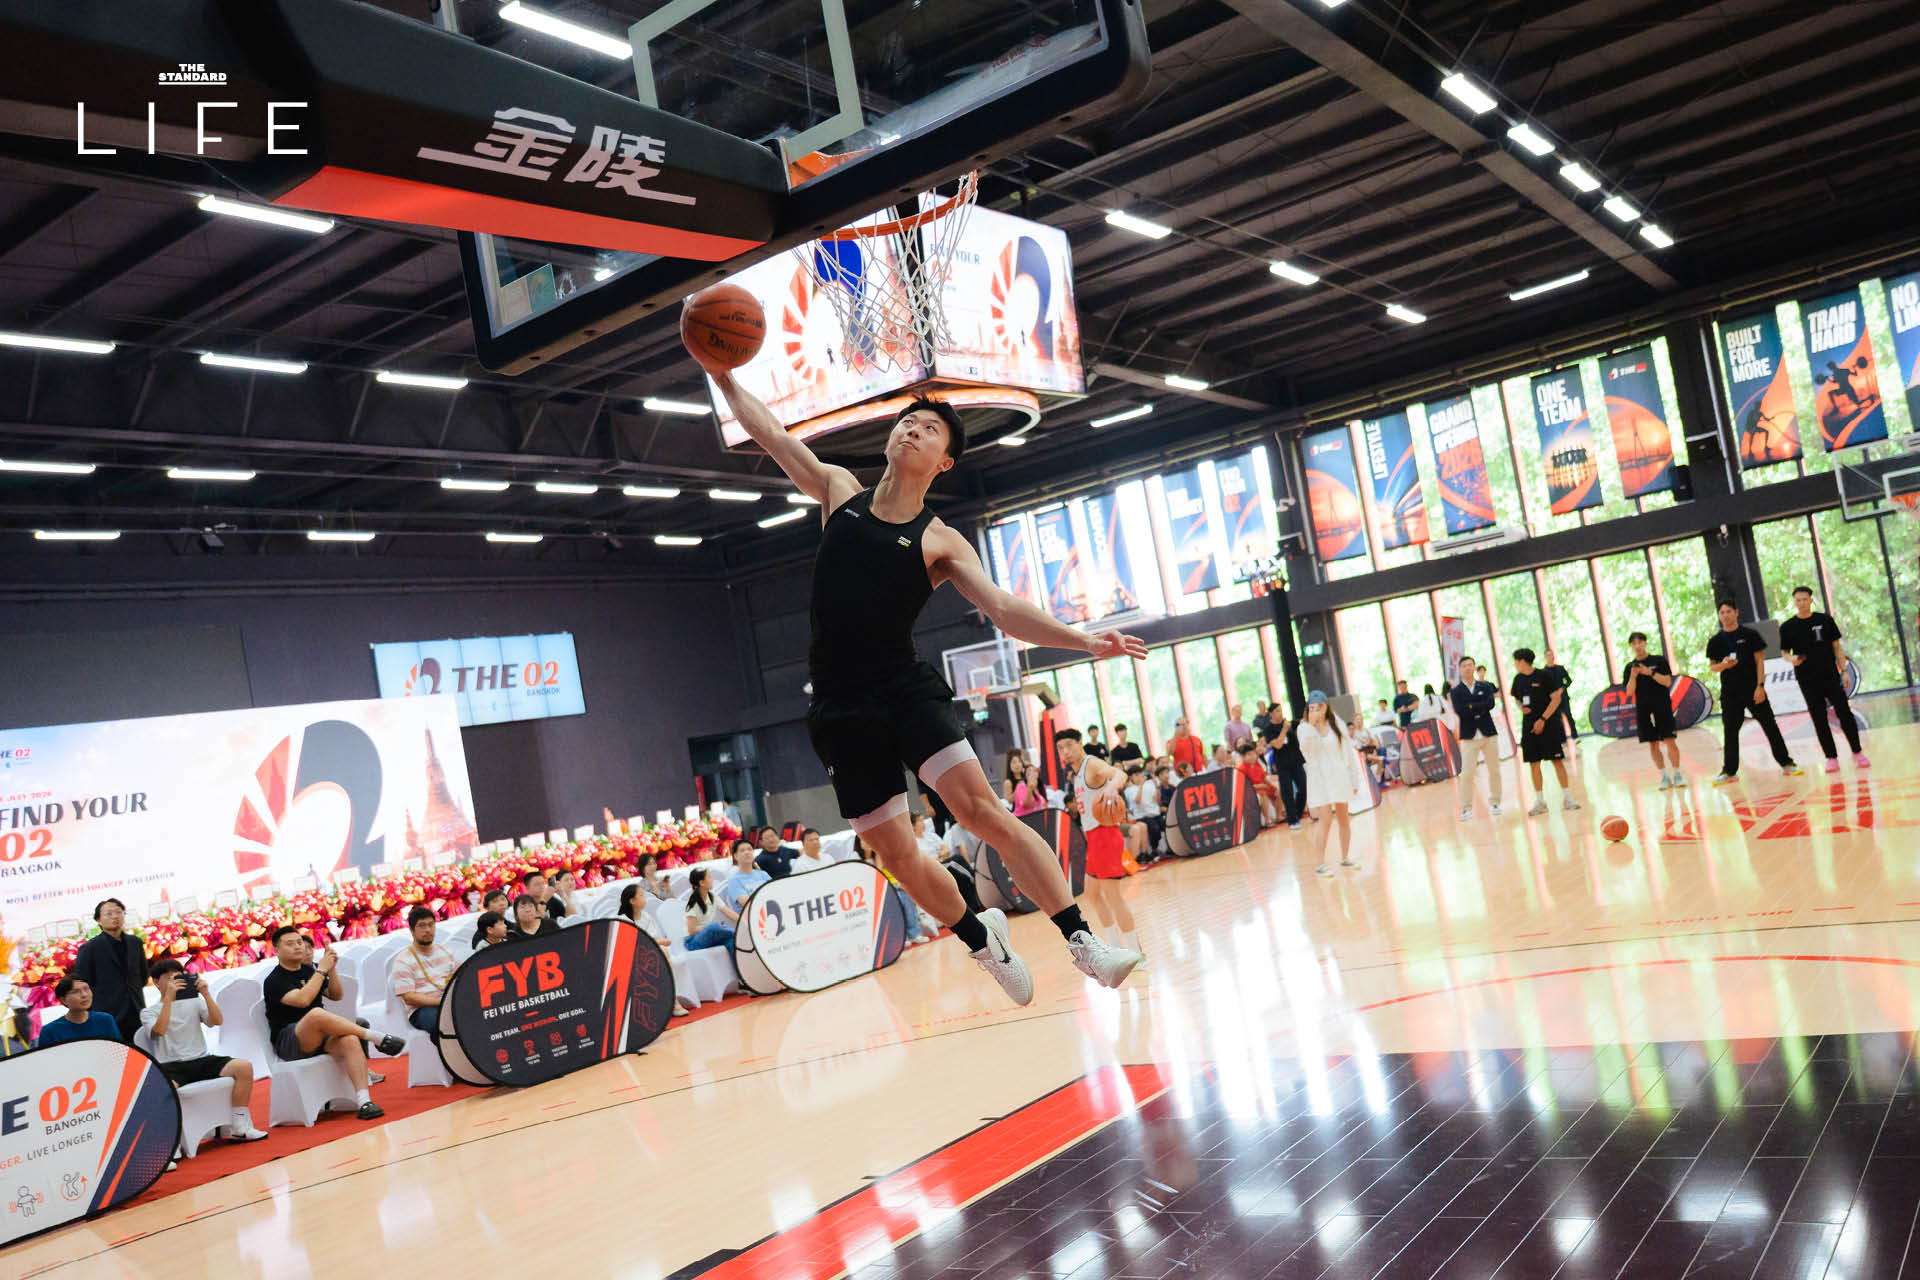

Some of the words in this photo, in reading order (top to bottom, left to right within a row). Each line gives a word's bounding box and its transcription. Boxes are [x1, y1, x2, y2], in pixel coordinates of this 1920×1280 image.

[416, 107, 697, 206] 金陵
[1890, 280, 1919, 312] NO
[1807, 300, 1857, 334] TRAIN
[1725, 323, 1762, 350] BUILT
[1810, 321, 1857, 354] HARD
[1728, 344, 1757, 368] FOR
[1731, 357, 1773, 383] MORE
[1536, 378, 1567, 406] ONE
[1539, 396, 1583, 427] TEAM
[1364, 420, 1389, 480] LIFESTYLE
[452, 663, 519, 693] THE
[523, 660, 560, 688] 02
[71, 792, 148, 821] YOUR
[1183, 783, 1219, 812] FYB
[0, 828, 53, 863] 02
[1, 860, 62, 878] BANGKOK
[788, 894, 837, 926] THE
[839, 886, 866, 912] 02
[477, 951, 565, 1008] FYB
[483, 1007, 498, 1020] FEI
[499, 1002, 517, 1015] YUE
[518, 987, 570, 1009] BASKETBALL
[490, 1031, 504, 1041] ONE
[558, 1011, 570, 1020] ONE
[38, 1077, 99, 1122] 02
[45, 1110, 102, 1136] BANGKOK
[27, 1143, 49, 1161] LIVE
[52, 1132, 94, 1153] LONGER
